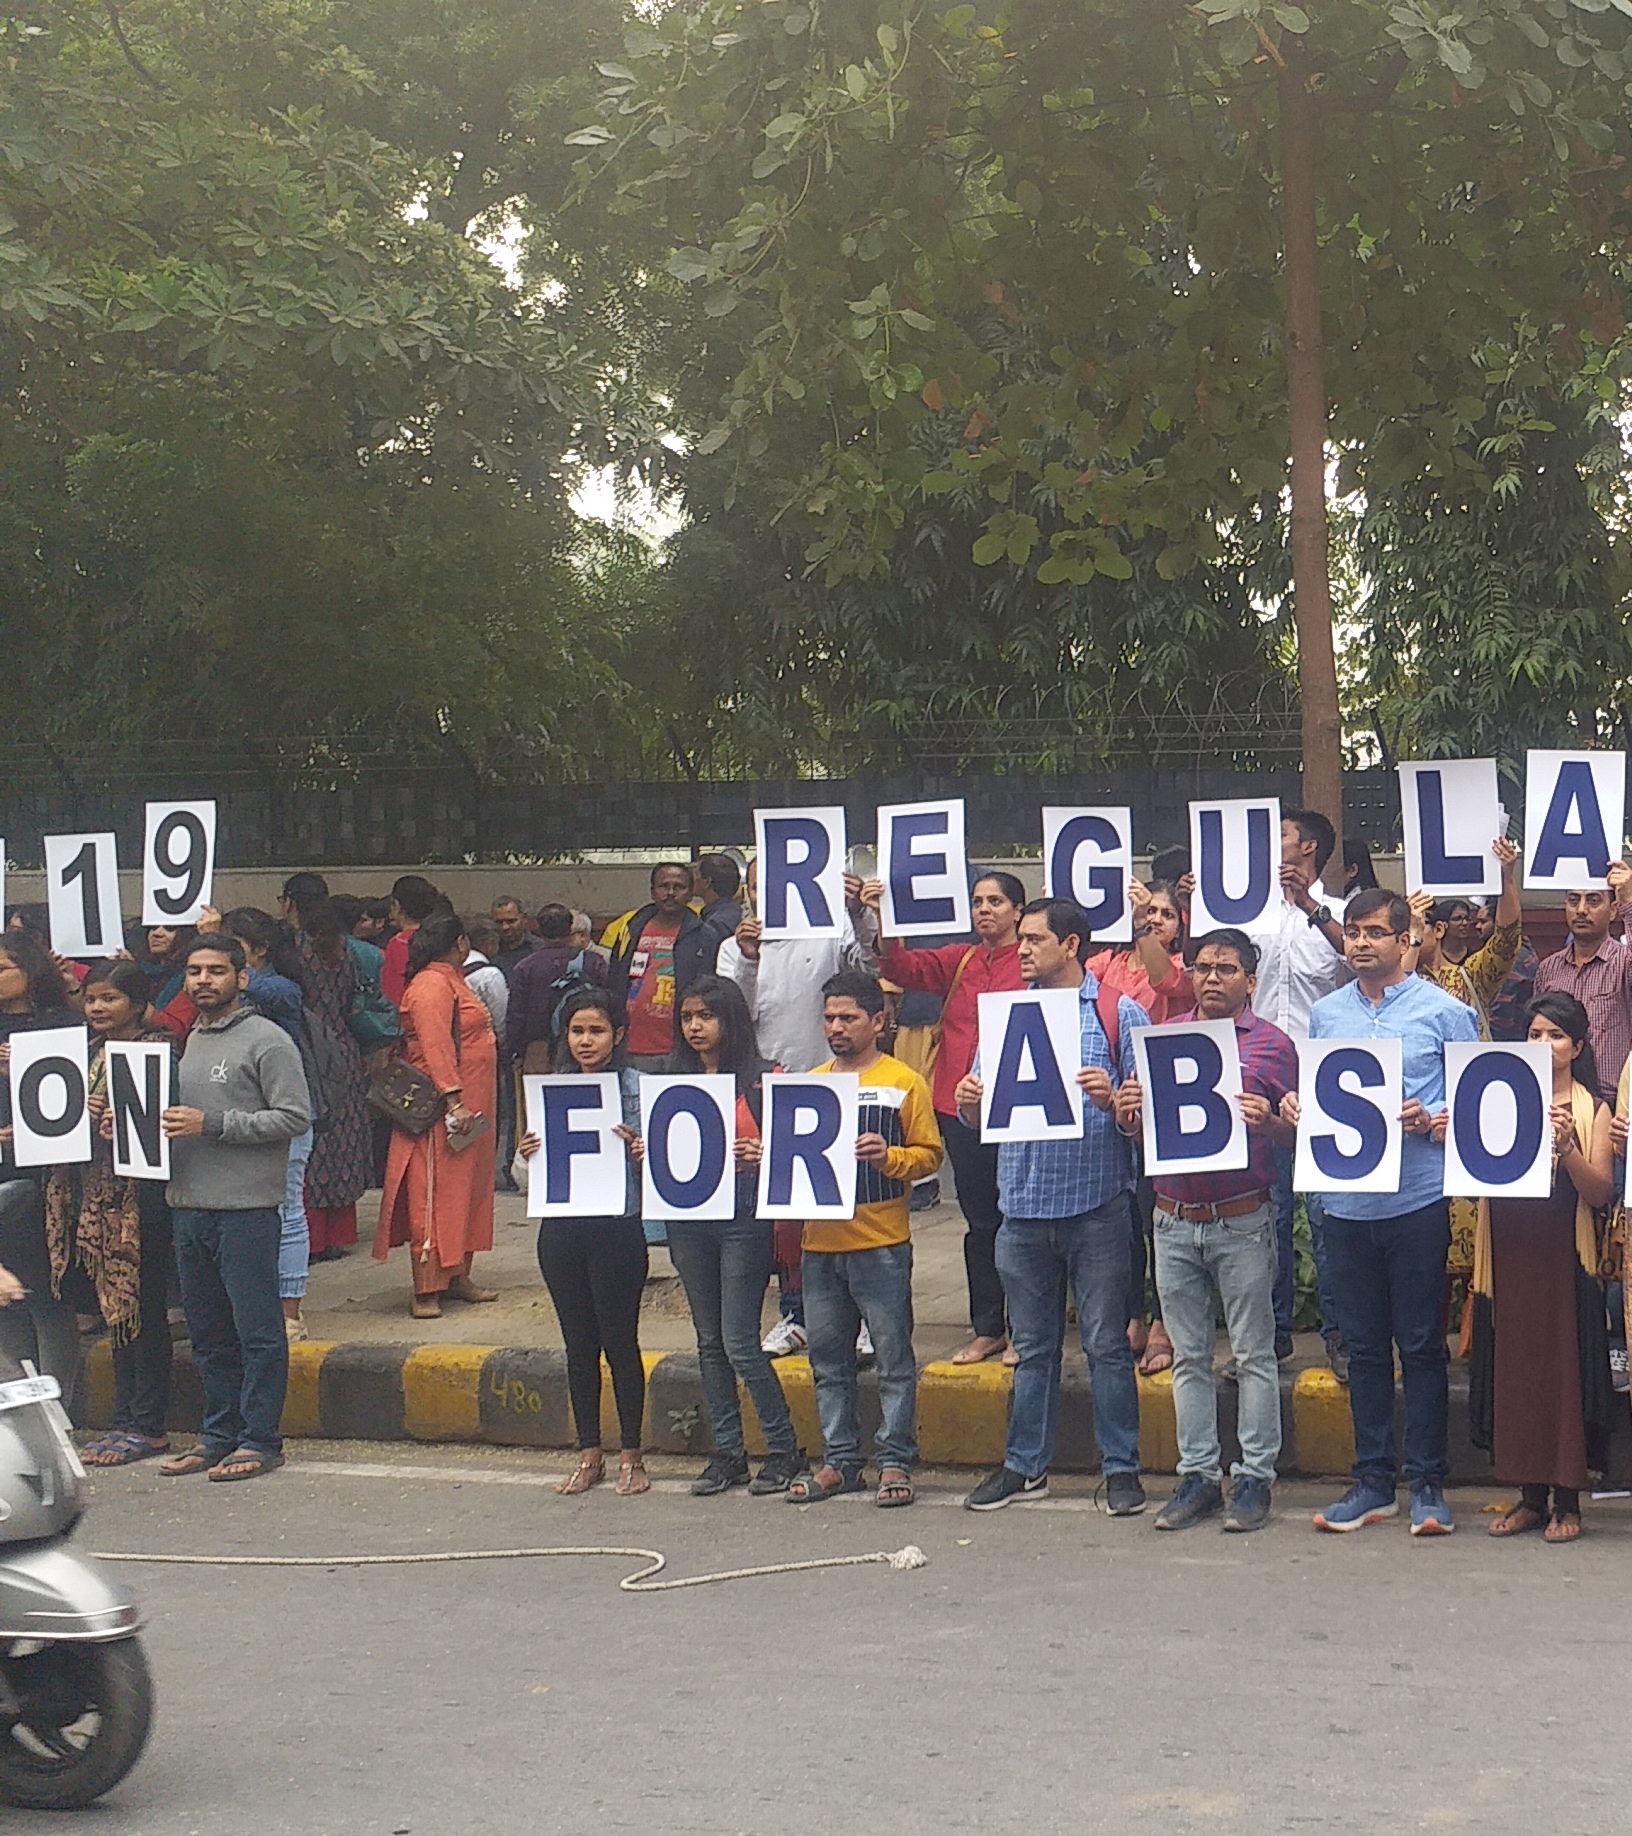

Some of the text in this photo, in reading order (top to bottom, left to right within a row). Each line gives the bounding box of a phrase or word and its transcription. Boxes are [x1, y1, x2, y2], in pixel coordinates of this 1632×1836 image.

[154, 811, 207, 915] 9
[763, 818, 834, 928] R
[890, 812, 955, 925] E
[1052, 816, 1124, 930] G
[1199, 808, 1271, 924] U
[1416, 770, 1484, 884] L
[1530, 761, 1612, 878] A
[62, 843, 102, 945] 1
[19, 1057, 85, 1137] O
[111, 1053, 161, 1167] N
[987, 1002, 1075, 1129] A
[1144, 1033, 1232, 1161] B
[1310, 1048, 1387, 1179] S
[1454, 1051, 1543, 1184] O
[542, 1084, 602, 1203] F
[648, 1085, 726, 1208] O
[767, 1084, 842, 1205] R
